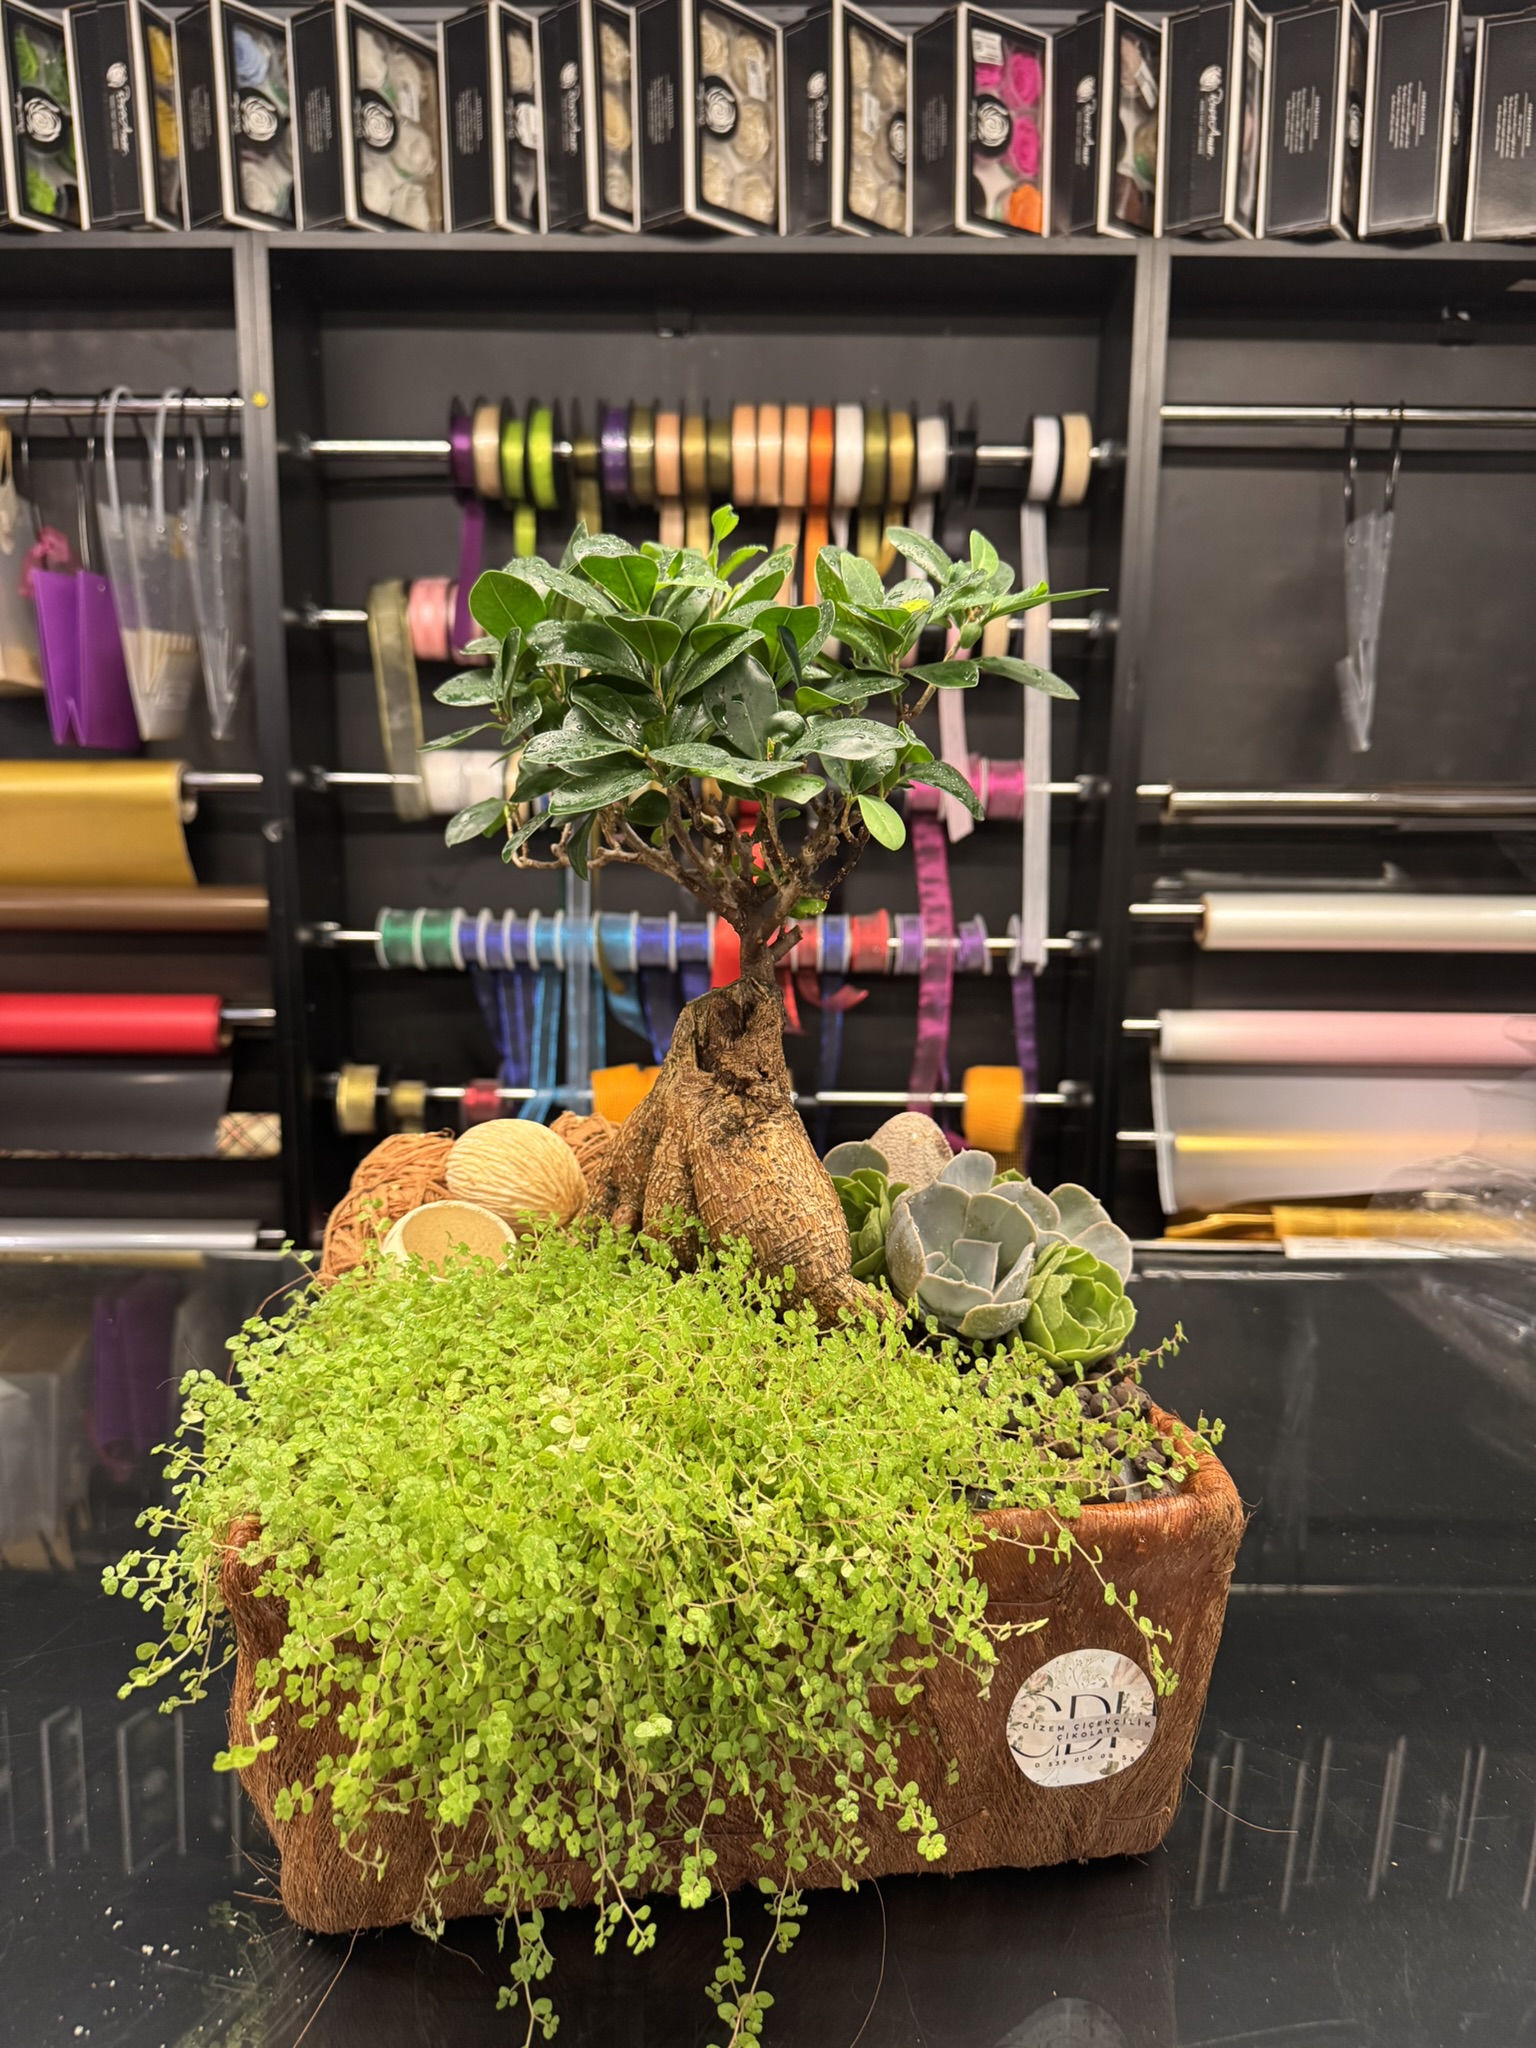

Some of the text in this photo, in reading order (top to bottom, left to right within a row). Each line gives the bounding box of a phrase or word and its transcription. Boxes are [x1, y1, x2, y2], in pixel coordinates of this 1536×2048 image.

[1022, 1722, 1065, 1732] GİZEM
[1057, 1727, 1120, 1741] ÇİKOLATA
[1074, 1755, 1093, 1763] 010
